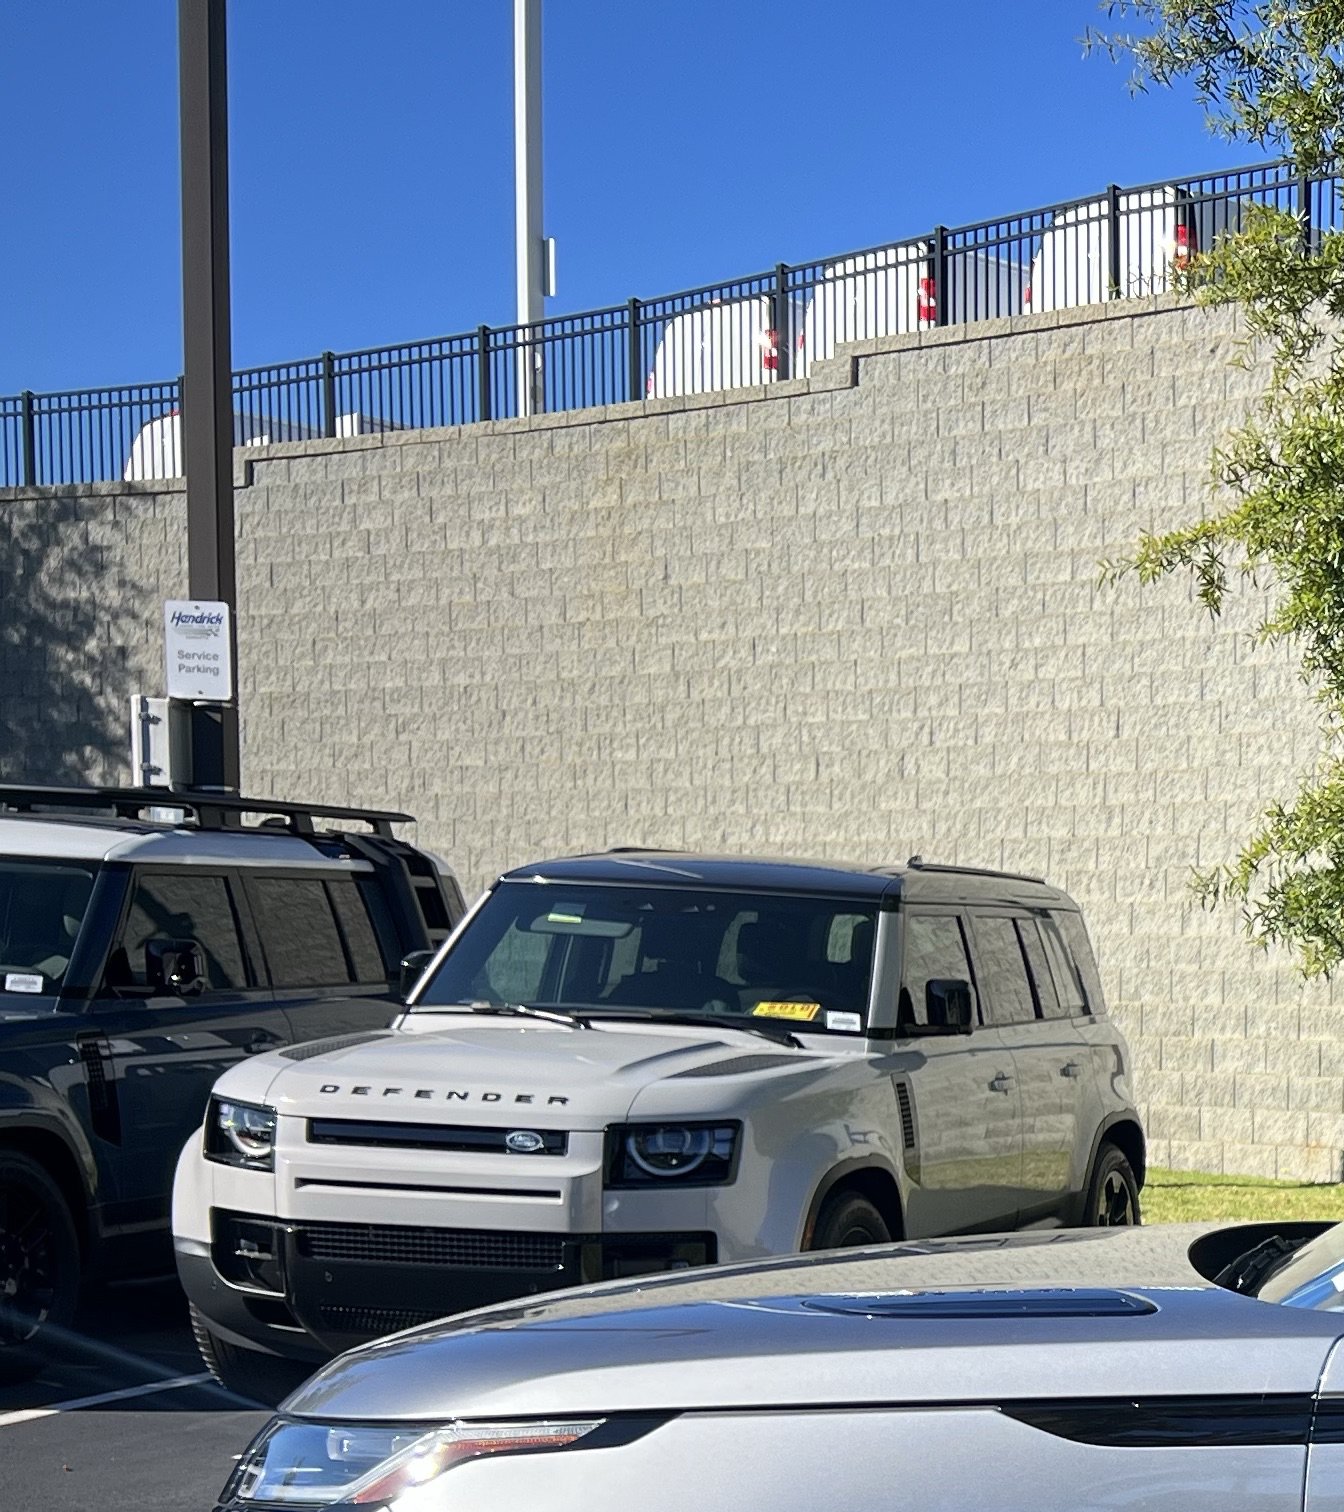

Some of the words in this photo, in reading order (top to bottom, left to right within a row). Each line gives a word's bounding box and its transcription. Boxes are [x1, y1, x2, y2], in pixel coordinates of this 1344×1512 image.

[170, 611, 224, 627] Hendrick
[177, 649, 219, 661] Service
[178, 663, 219, 676] Parking
[320, 1084, 569, 1106] DEFENDER
